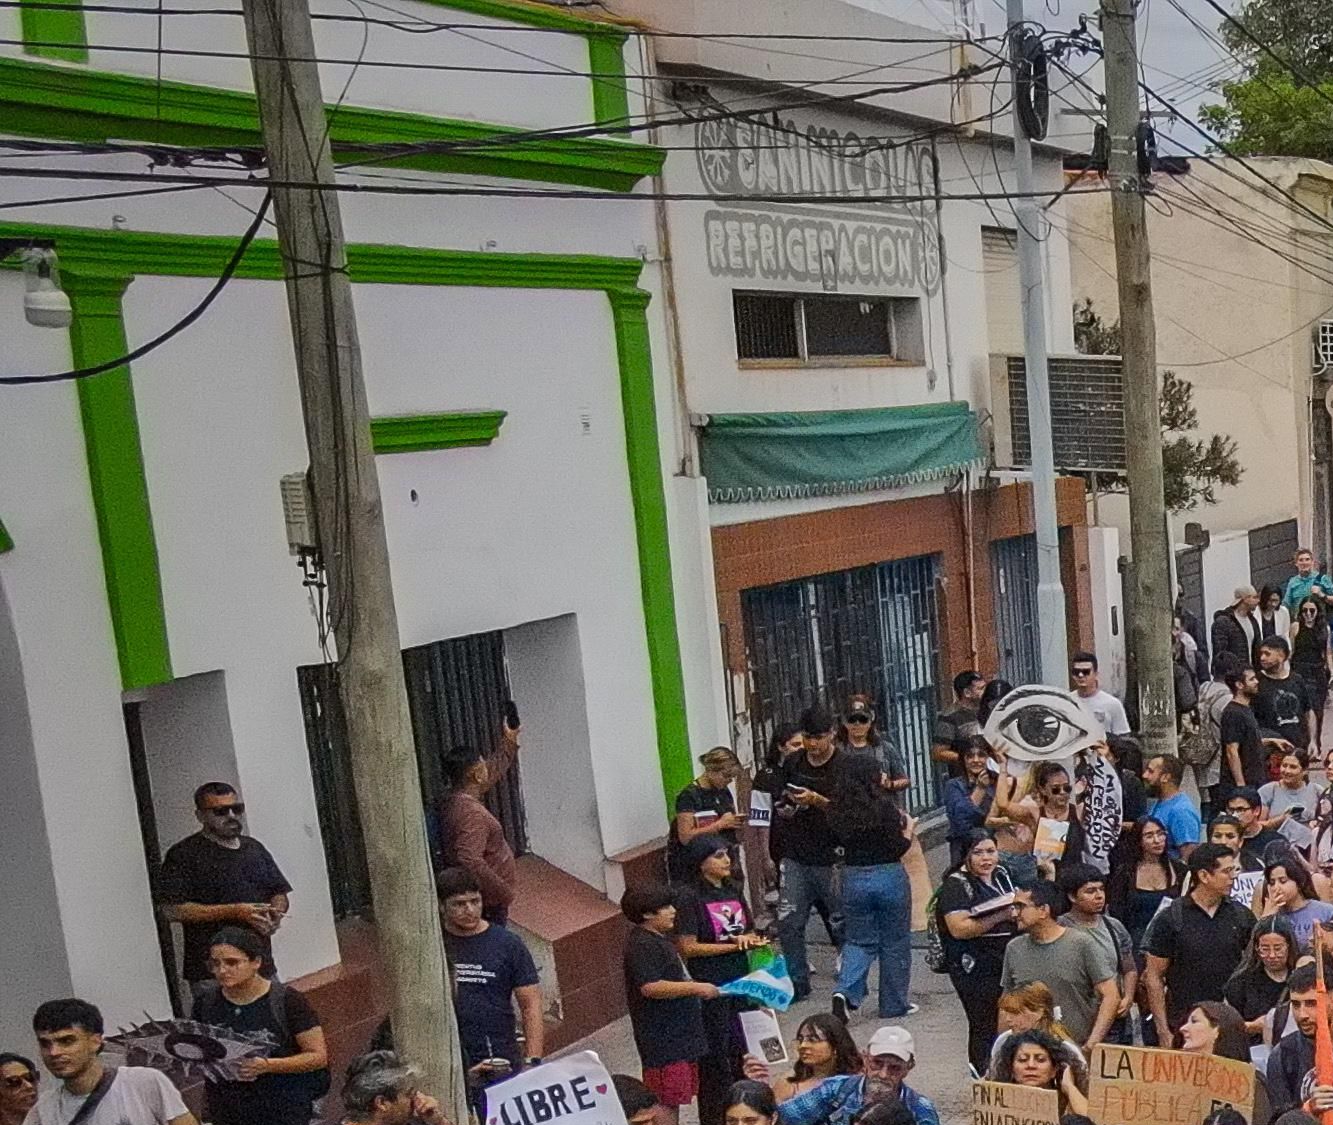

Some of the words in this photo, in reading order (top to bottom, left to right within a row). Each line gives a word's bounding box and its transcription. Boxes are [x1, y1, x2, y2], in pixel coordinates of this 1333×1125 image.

[705, 216, 916, 287] REFRIGERACION
[1100, 1049, 1135, 1081] LA
[972, 1083, 992, 1106] FIN
[994, 1087, 1009, 1109] AL
